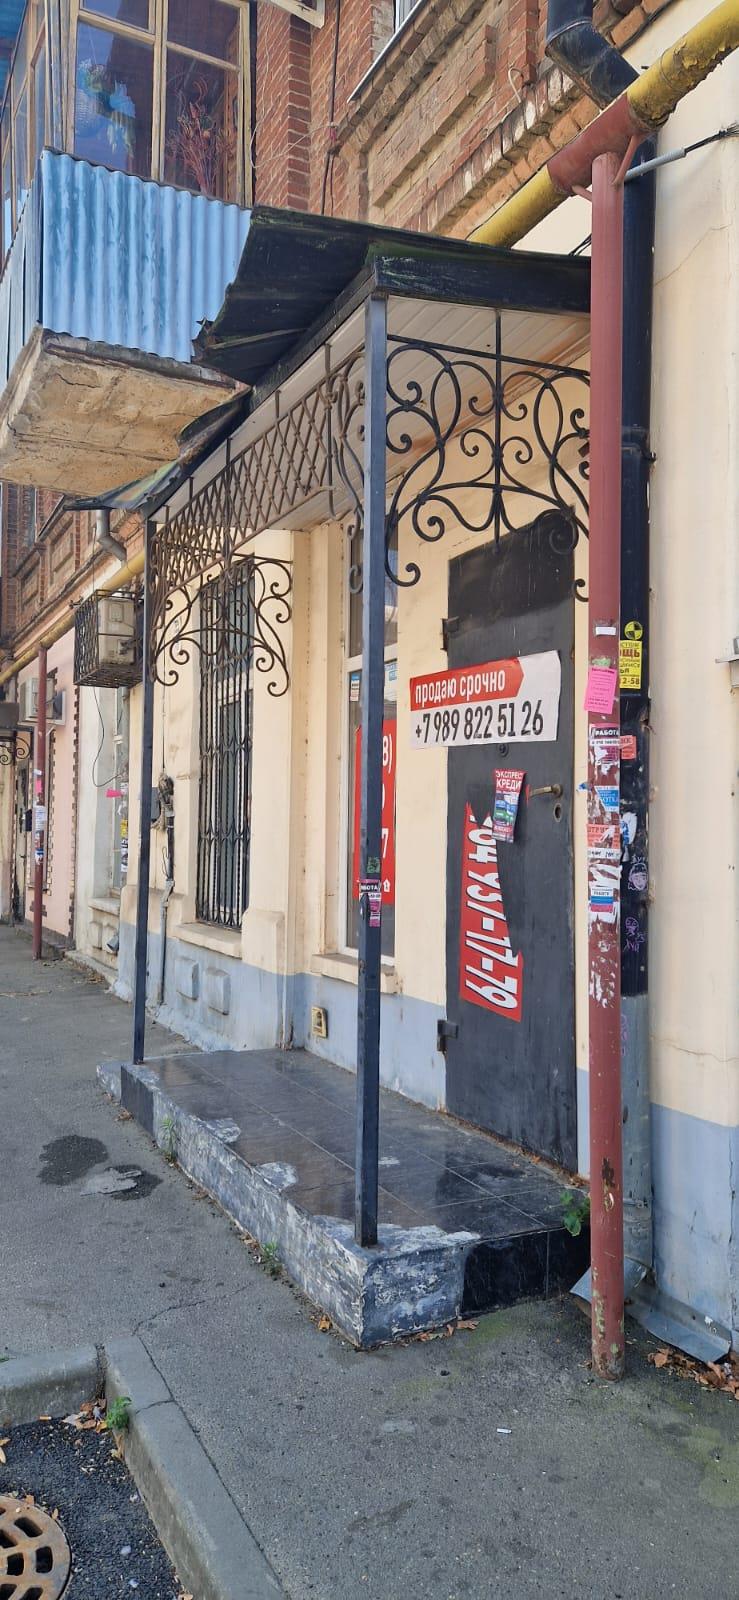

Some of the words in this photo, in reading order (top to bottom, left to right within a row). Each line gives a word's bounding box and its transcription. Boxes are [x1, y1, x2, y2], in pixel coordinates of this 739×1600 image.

[415, 678, 457, 708] продаю
[459, 669, 506, 701] срочно
[415, 713, 431, 744] +7
[433, 708, 460, 743] 989
[463, 704, 494, 740] 822
[497, 702, 516, 737] 51
[520, 699, 544, 736] 26
